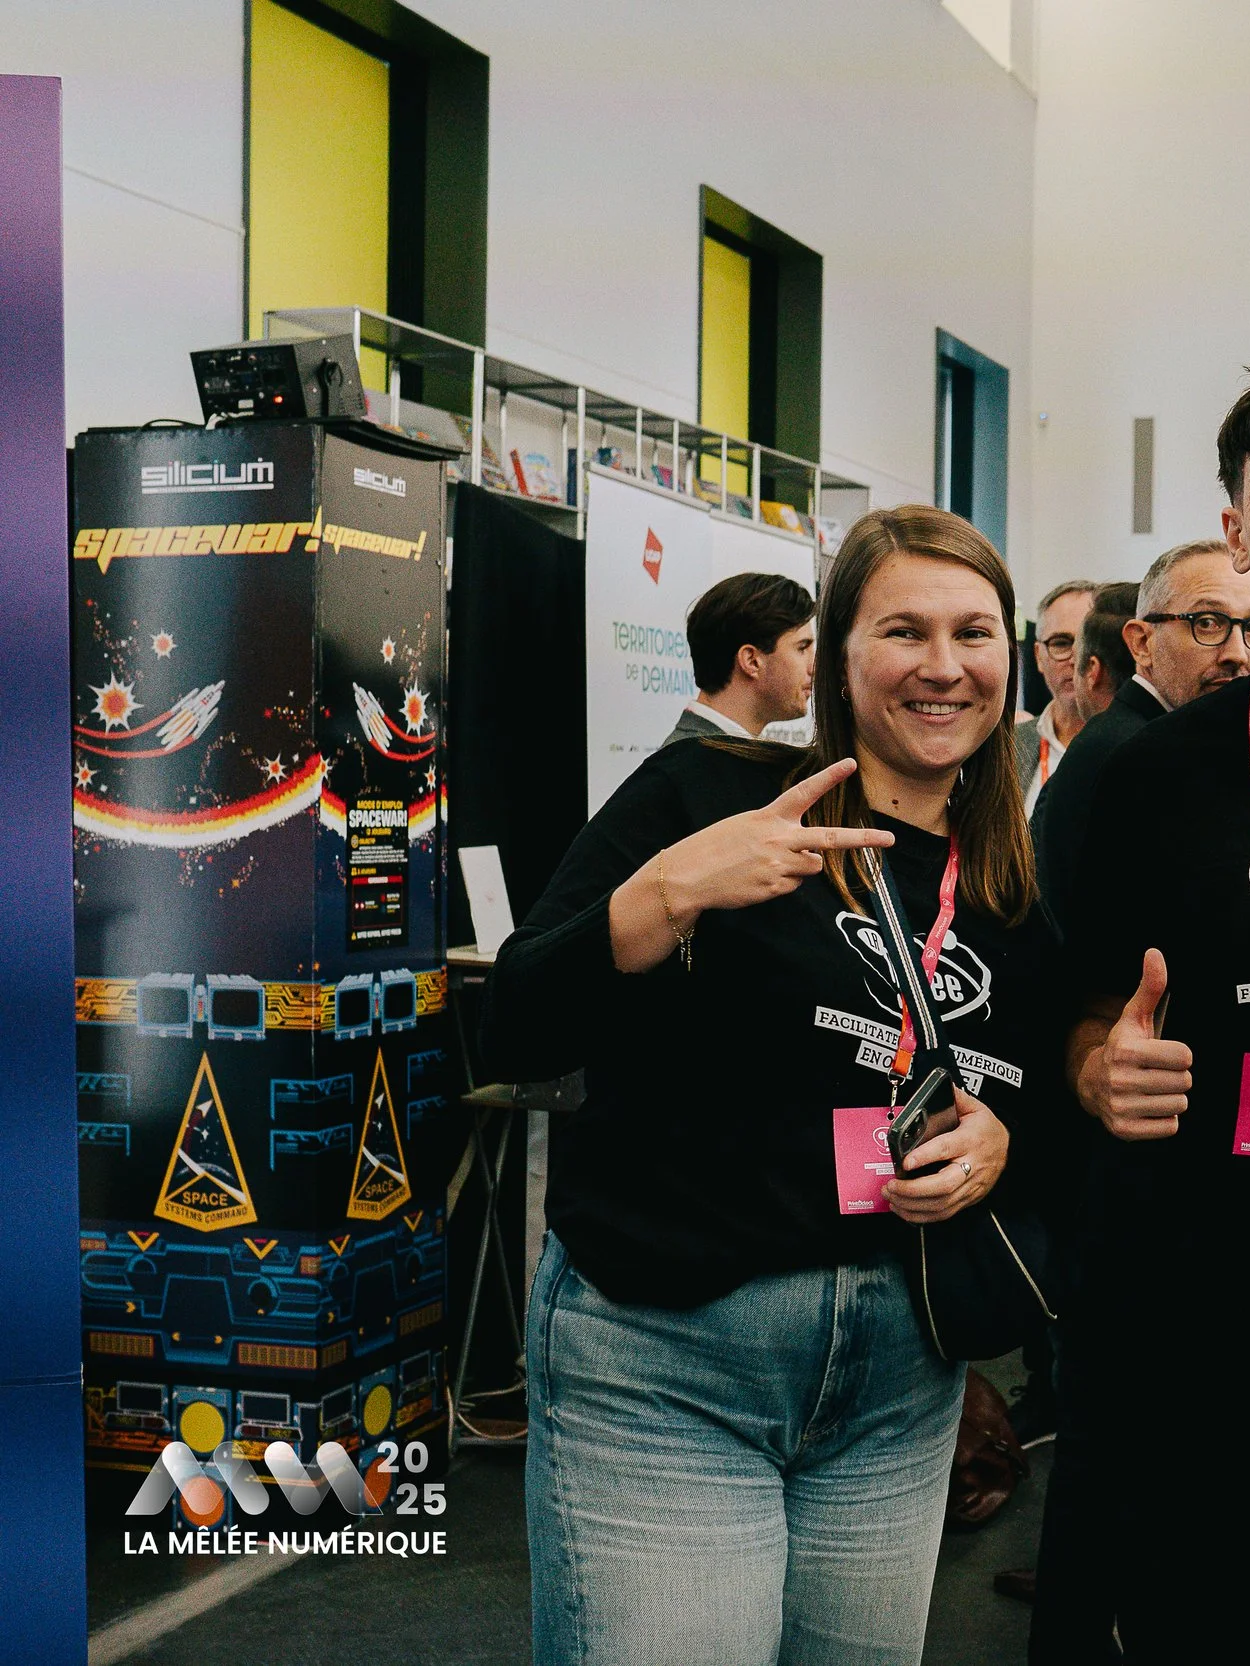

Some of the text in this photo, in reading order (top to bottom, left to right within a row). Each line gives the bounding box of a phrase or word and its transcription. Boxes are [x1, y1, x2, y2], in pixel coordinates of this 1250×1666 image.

[74, 504, 322, 576] spacewar!
[323, 523, 427, 561] spacewar!
[819, 1011, 900, 1046] FACILITATE
[860, 1047, 882, 1065] EN
[182, 1191, 229, 1206] SPACE
[164, 1202, 248, 1224] SYSTEMS COMMAND
